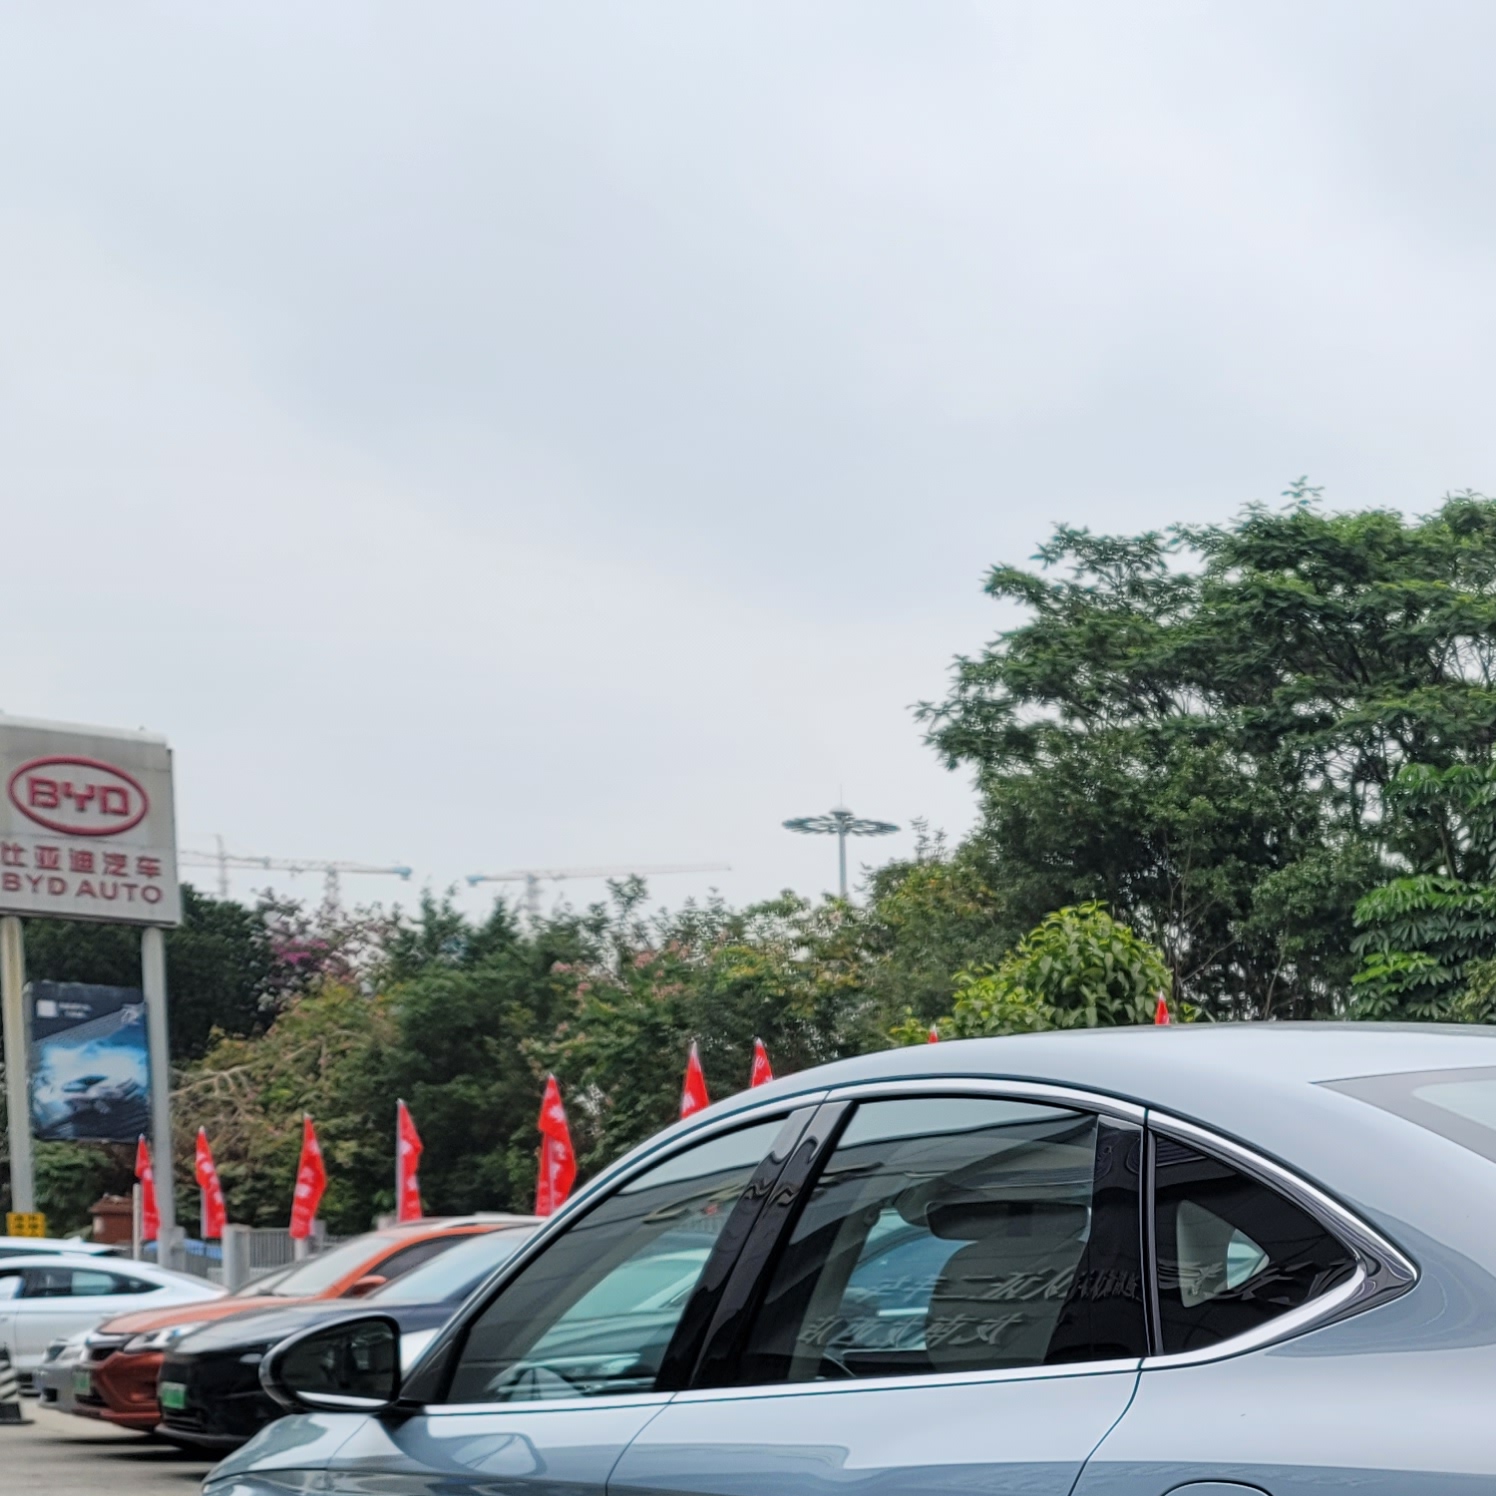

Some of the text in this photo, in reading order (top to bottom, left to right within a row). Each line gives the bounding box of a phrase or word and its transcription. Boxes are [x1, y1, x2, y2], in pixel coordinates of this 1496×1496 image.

[28, 776, 130, 816] BYD
[0, 842, 162, 878] 比亚迪汽车
[2, 872, 163, 904] BYD AUTO
